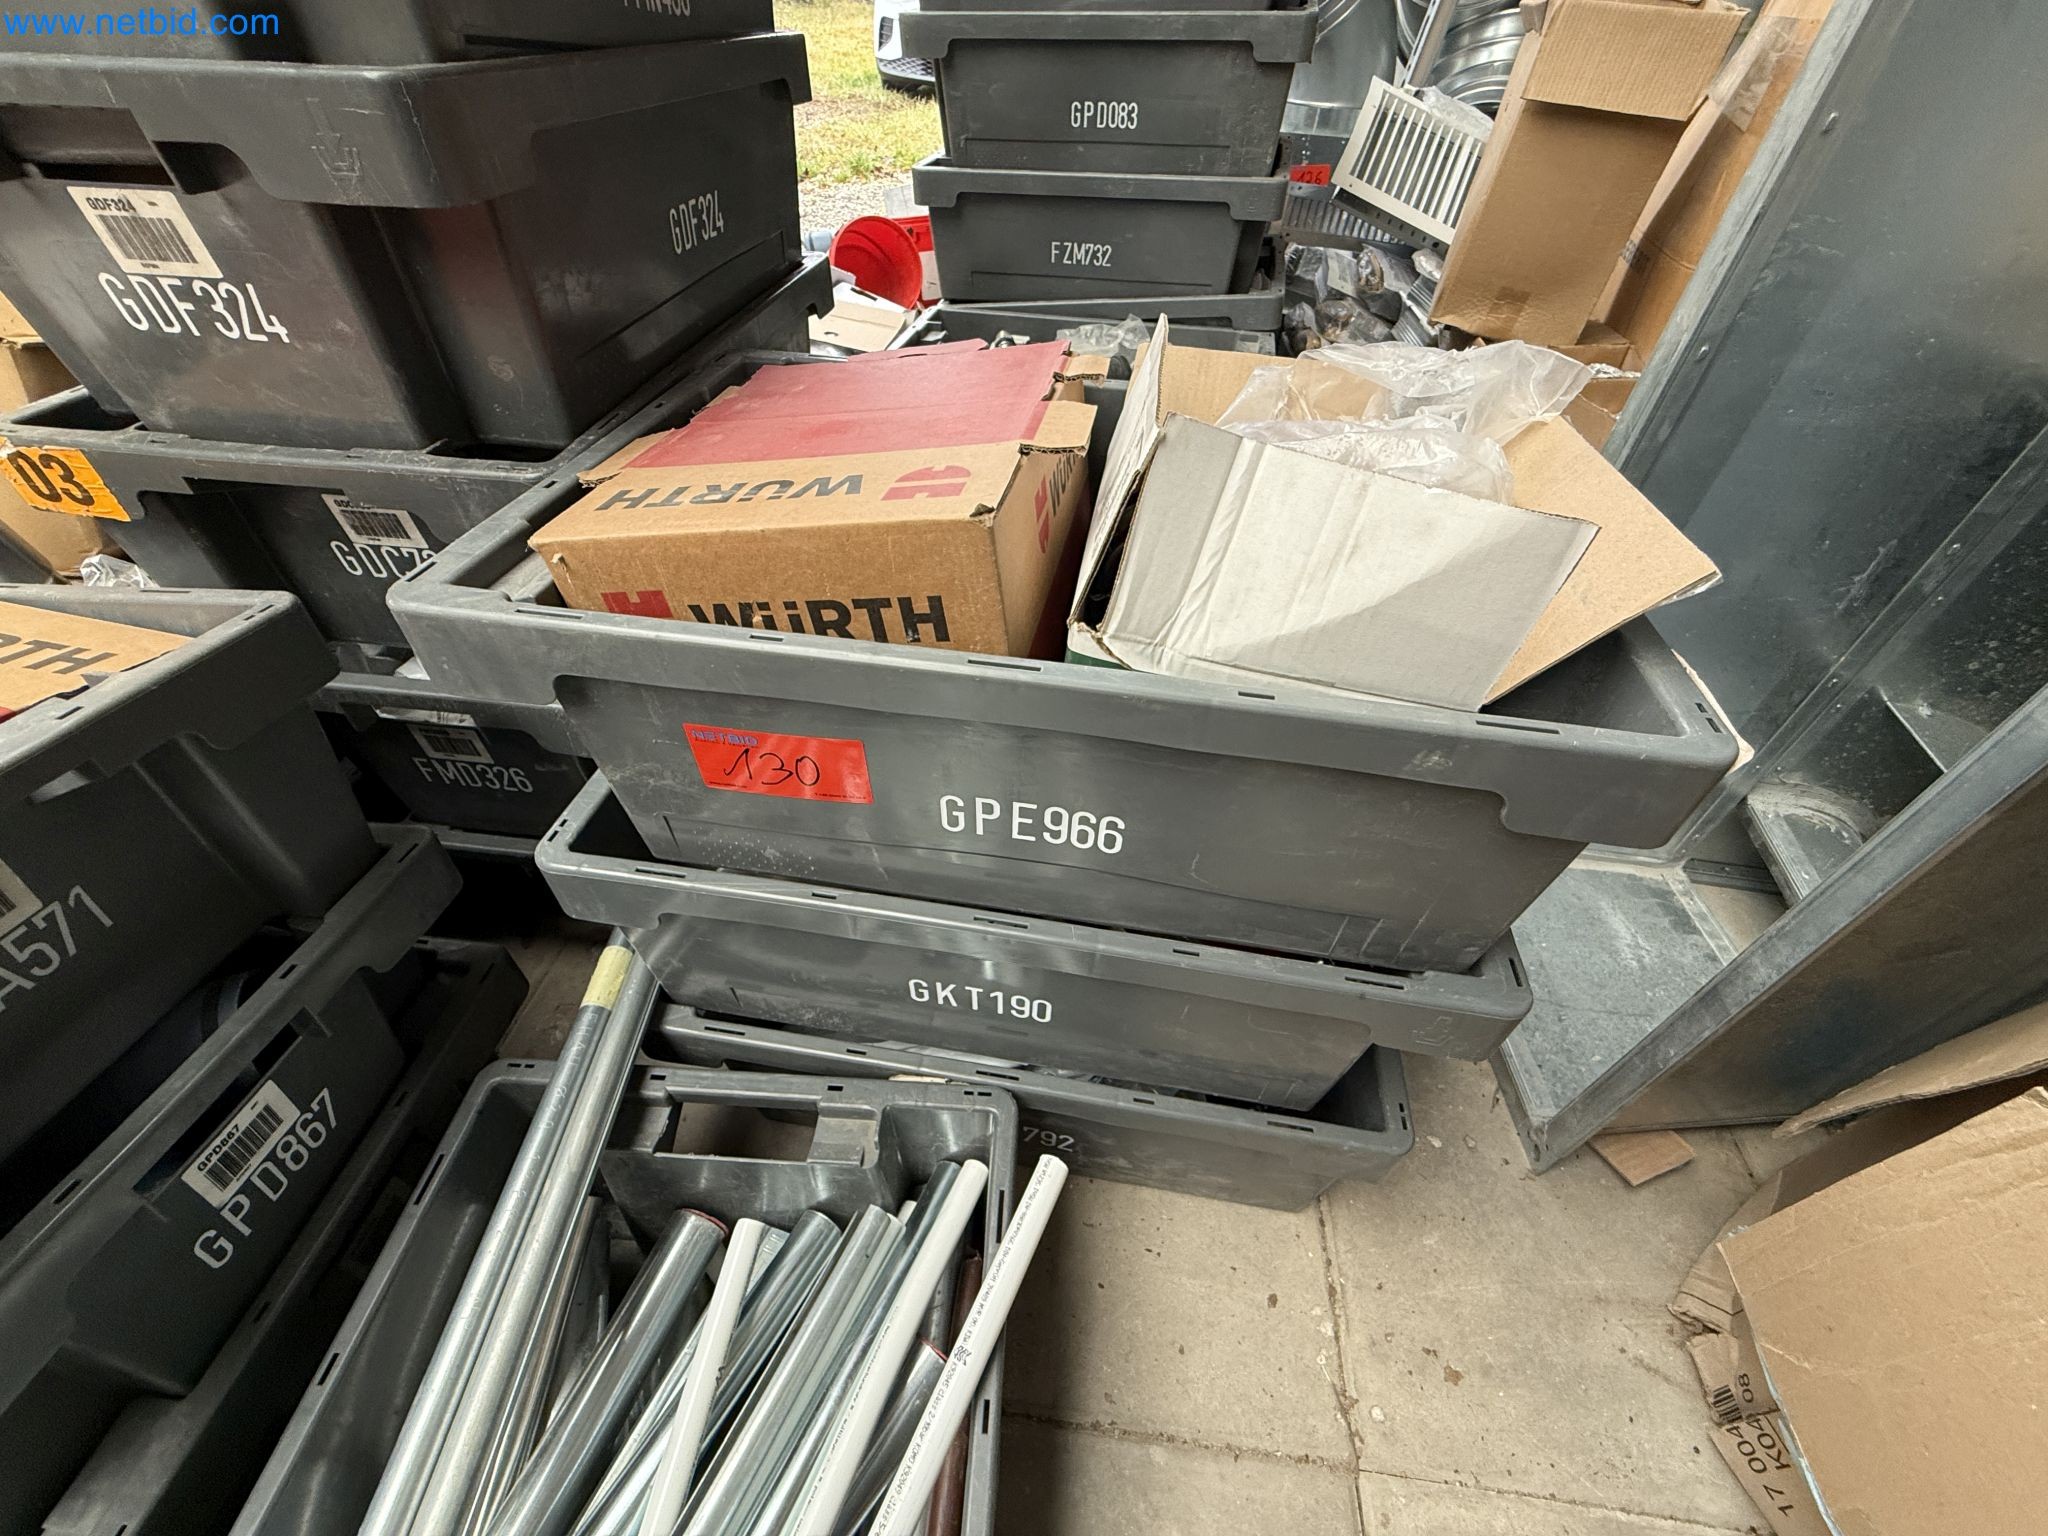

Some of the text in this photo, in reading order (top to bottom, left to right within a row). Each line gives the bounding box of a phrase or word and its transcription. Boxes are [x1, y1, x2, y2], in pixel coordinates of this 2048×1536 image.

[1070, 101, 1138, 129] GPD083
[85, 197, 138, 213] GDF324
[669, 190, 724, 255] GDF324
[1051, 241, 1113, 267] FZM732
[98, 272, 290, 343] GDF324
[410, 756, 534, 793] FMD326
[723, 748, 820, 787] 130
[939, 795, 1126, 854] GPE966
[908, 978, 1053, 1023] GKT190
[197, 1123, 239, 1171] GPD867
[1022, 1126, 1075, 1152] 792
[193, 1087, 337, 1269] GPD867
[1737, 1373, 1754, 1403] 08
[1746, 1418, 1791, 1470] K04
[1726, 1425, 1794, 1517] 17 004
